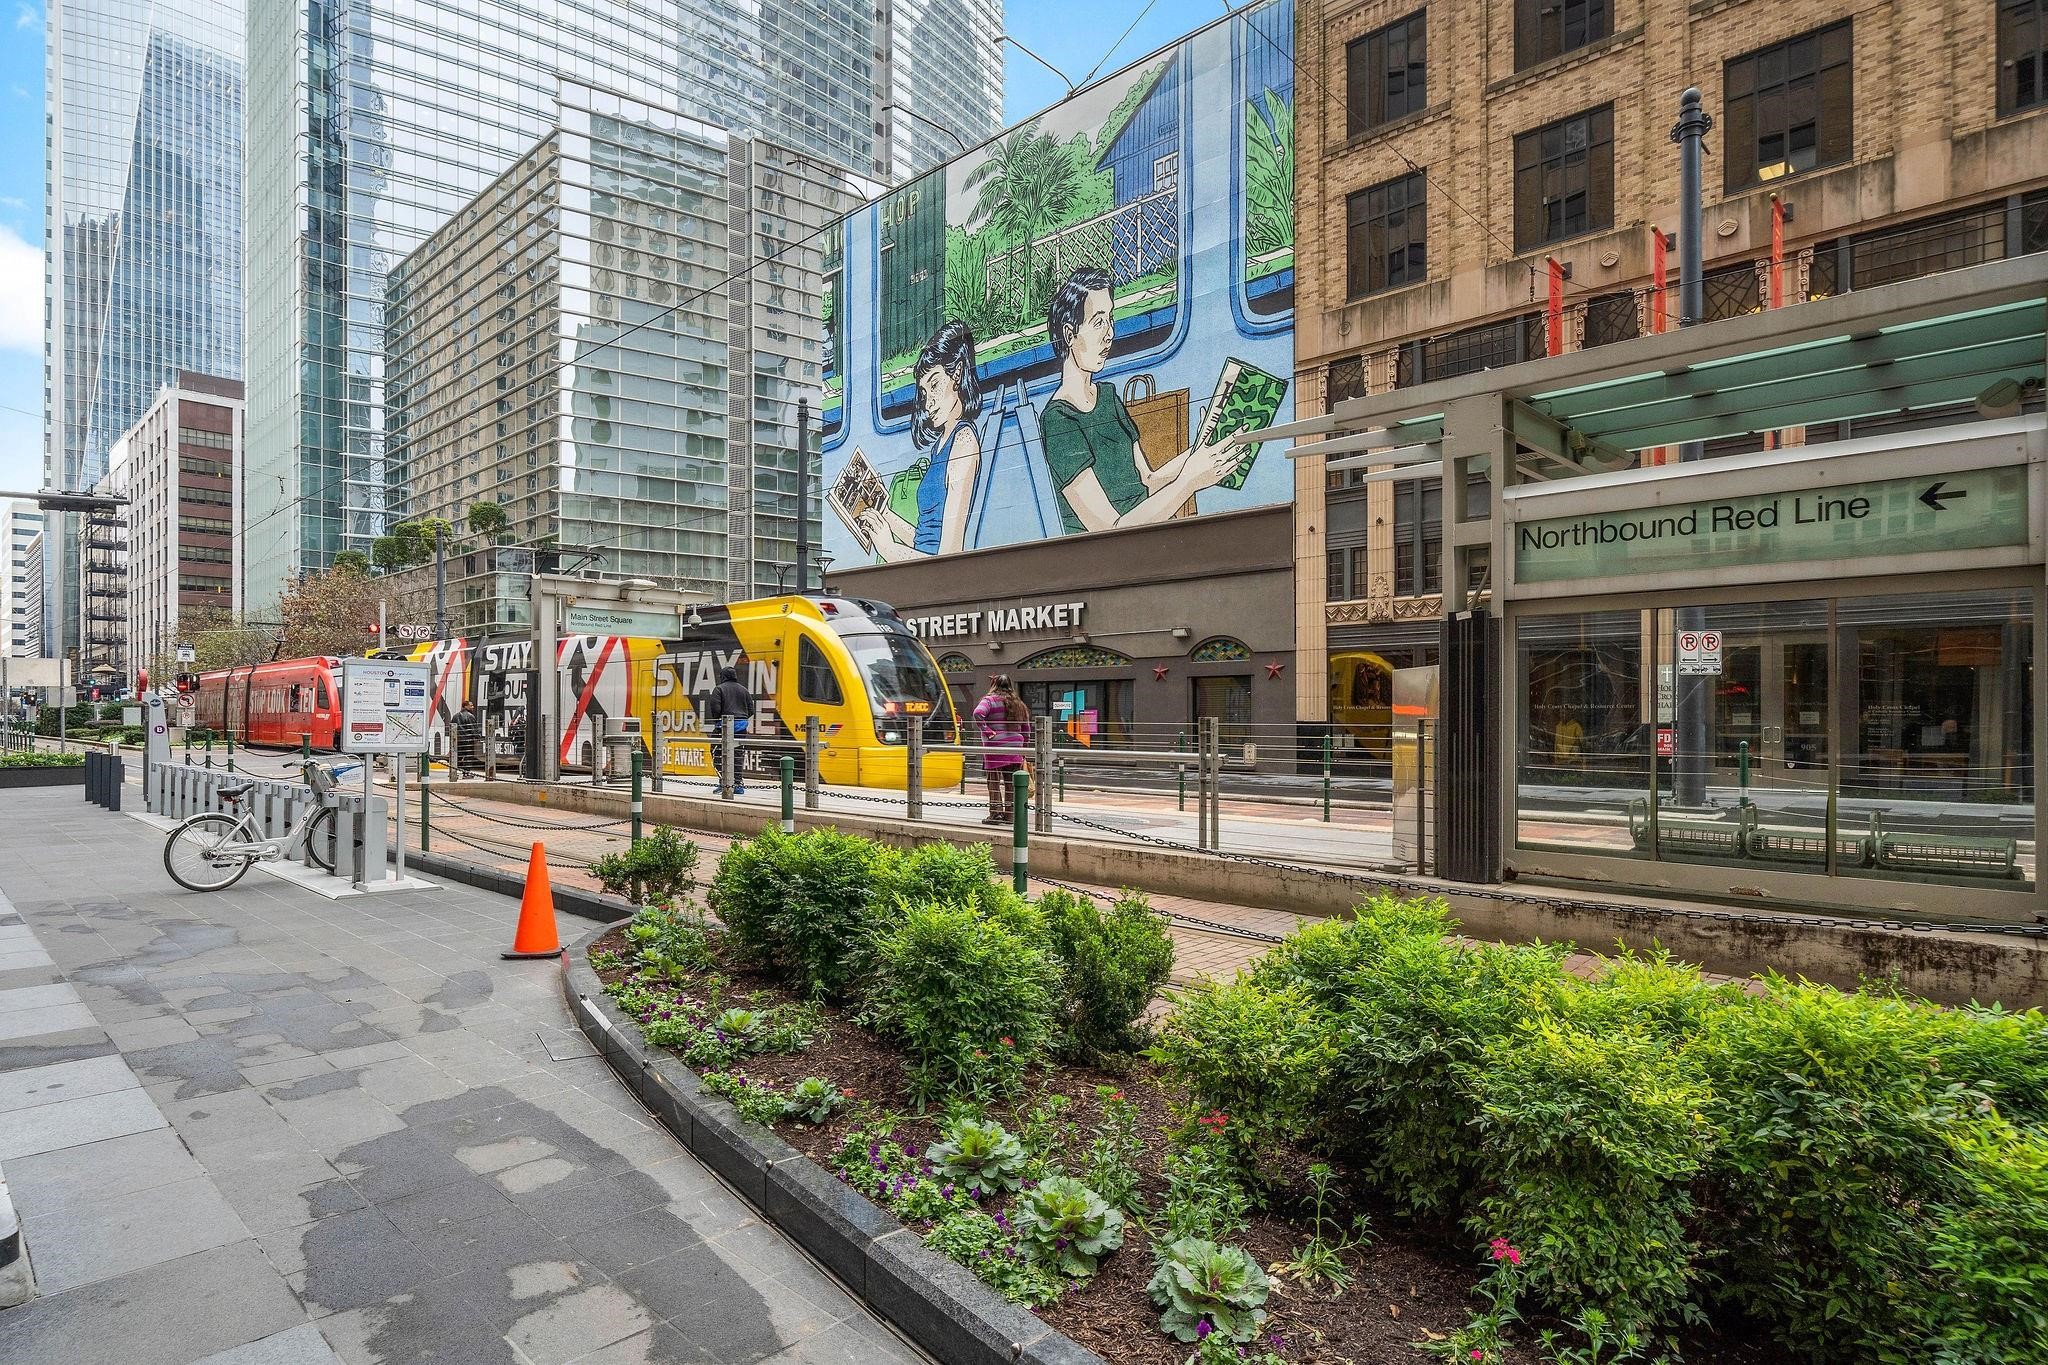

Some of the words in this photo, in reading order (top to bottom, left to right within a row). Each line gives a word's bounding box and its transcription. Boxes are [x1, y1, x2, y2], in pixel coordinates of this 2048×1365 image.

[1522, 509, 1697, 550] Northbound
[1712, 500, 1778, 533] Red
[1795, 495, 1870, 524] Line
[570, 612, 588, 621] Main
[589, 614, 609, 623] Street
[610, 615, 633, 625] Square
[906, 612, 981, 638] STREET
[988, 602, 1084, 632] MARKET
[484, 641, 532, 671] STAY
[748, 660, 777, 695] IN
[267, 687, 287, 714] LOOK
[1563, 703, 1583, 711] Chapel
[1899, 704, 1921, 712] Chapel
[1800, 743, 1817, 751] 905
